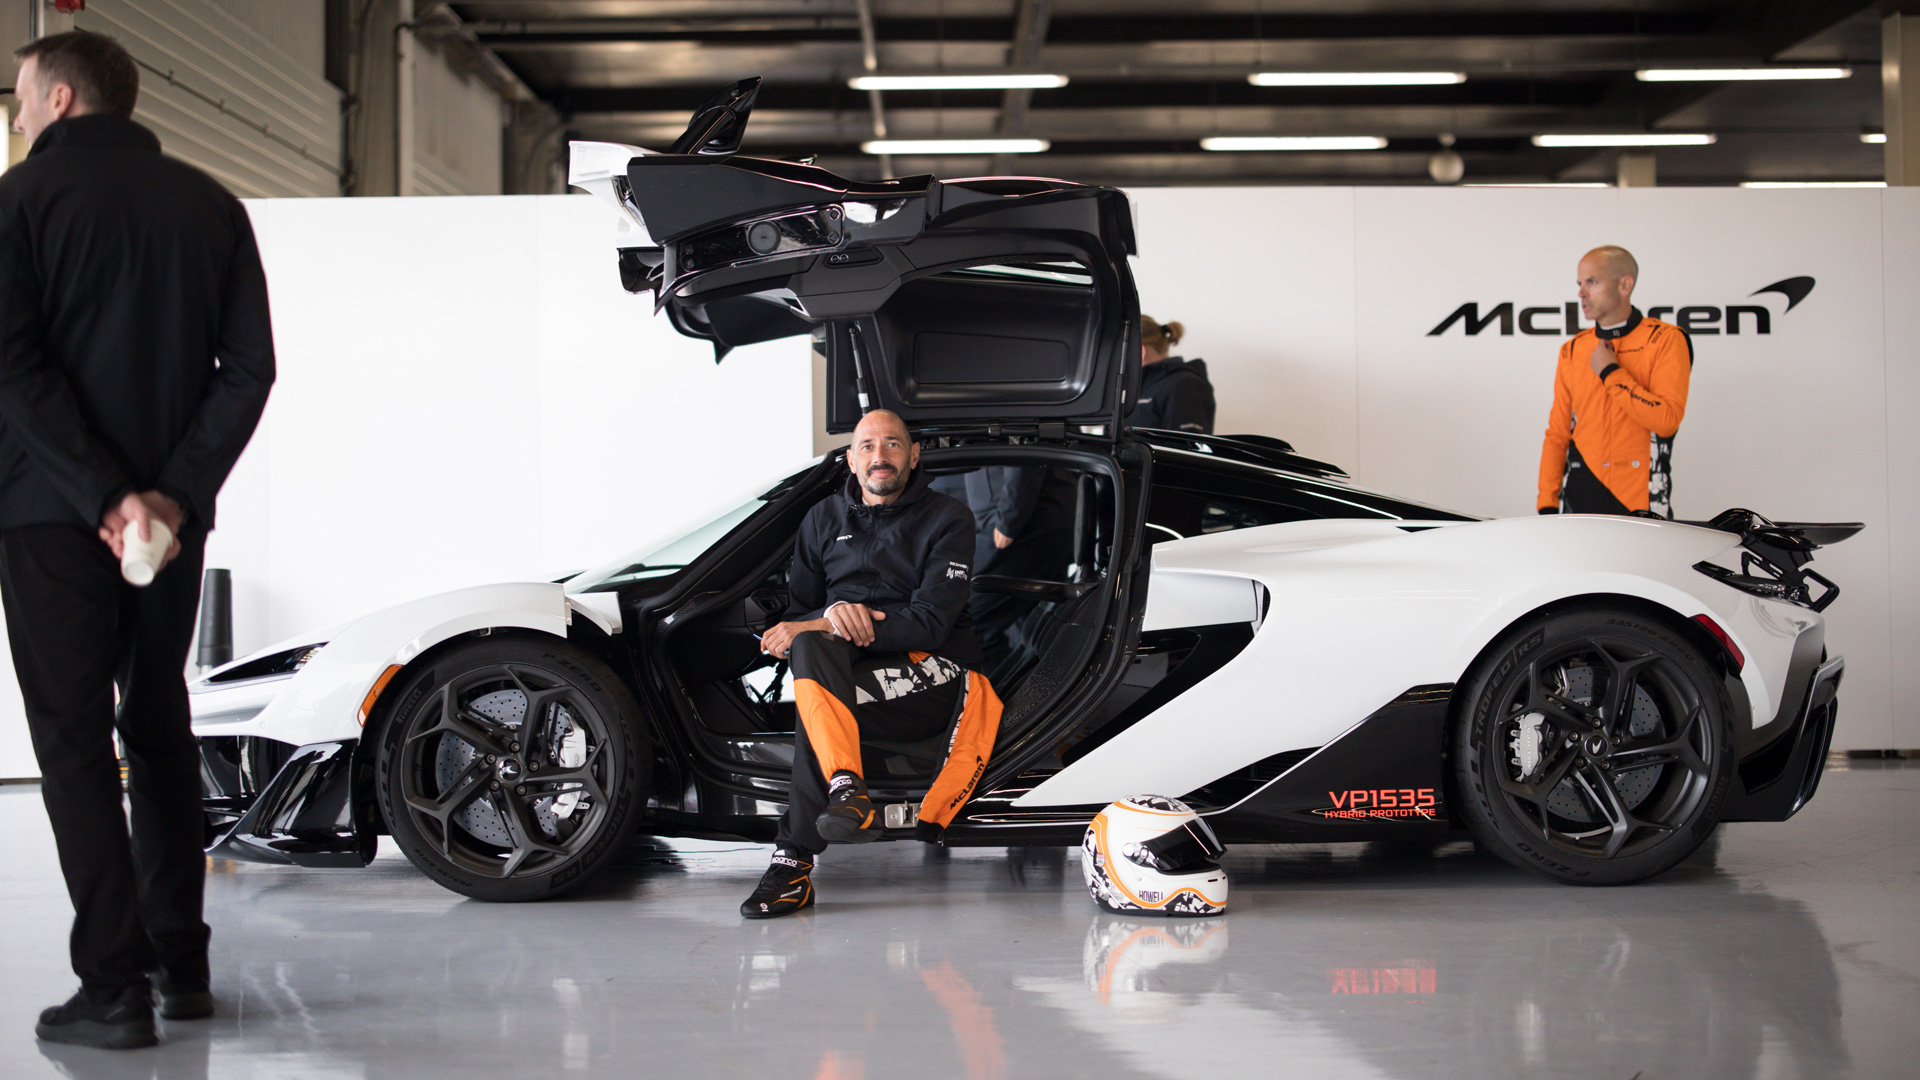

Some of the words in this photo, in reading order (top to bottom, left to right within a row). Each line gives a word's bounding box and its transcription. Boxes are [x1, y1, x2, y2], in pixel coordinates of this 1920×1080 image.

[1426, 302, 1770, 335] McLren
[557, 659, 602, 692] ZERO
[1474, 660, 1513, 736] TROFEO
[1518, 634, 1543, 657] RS
[950, 763, 985, 810] McLaren
[1328, 788, 1435, 809] VP1535
[1324, 810, 1367, 819] HYBRID
[1370, 808, 1436, 818] PROTOTYPE
[1516, 842, 1573, 873] ZERO
